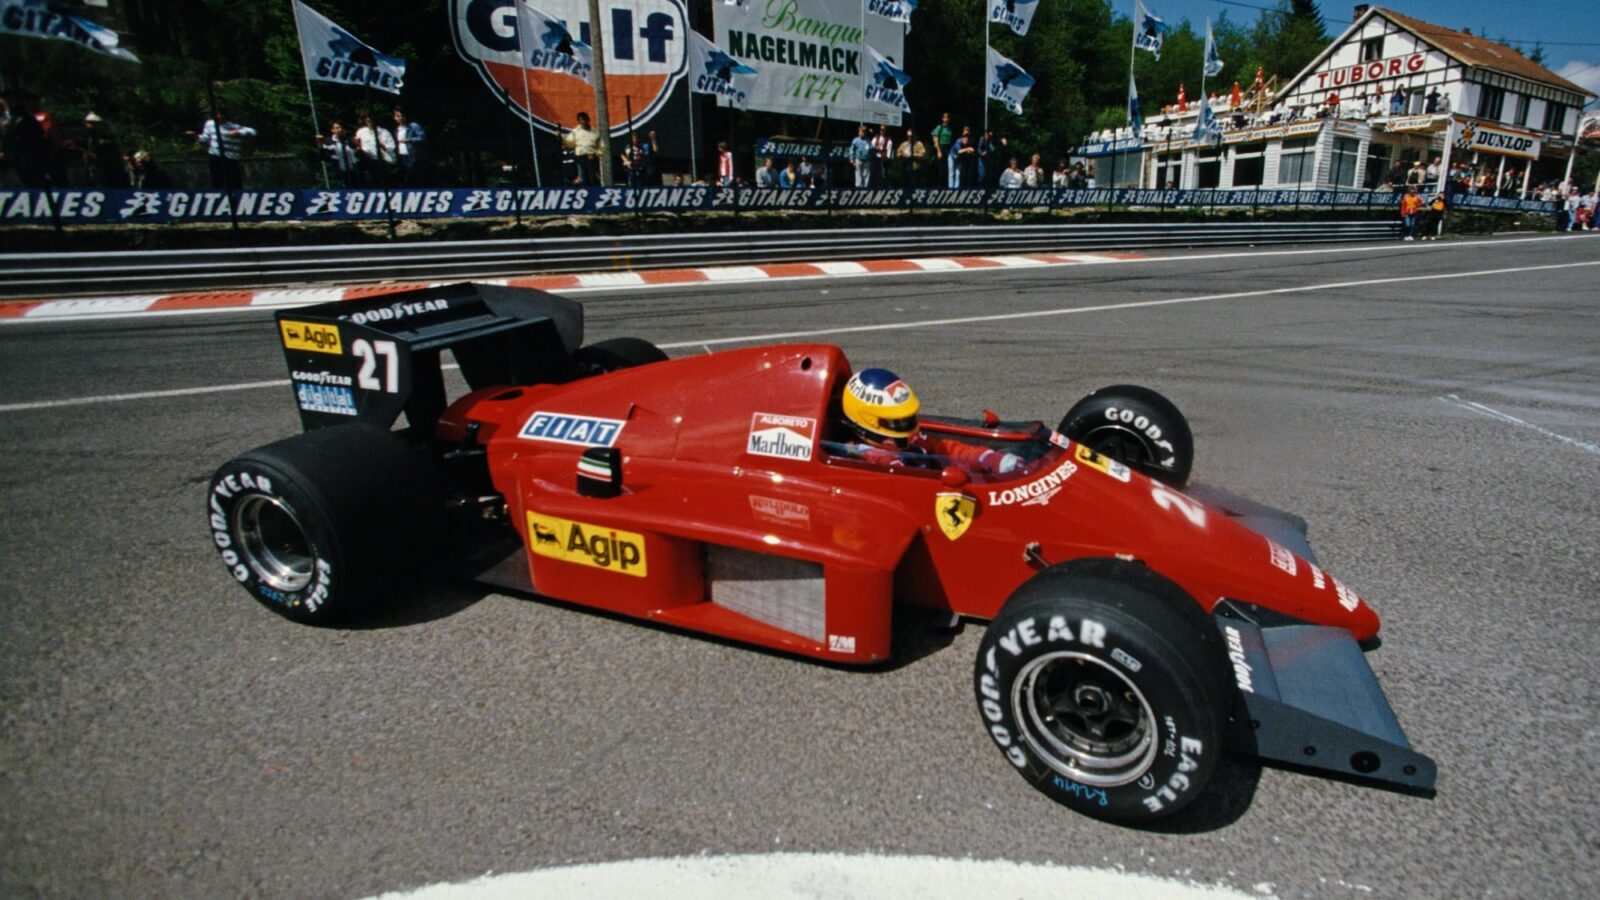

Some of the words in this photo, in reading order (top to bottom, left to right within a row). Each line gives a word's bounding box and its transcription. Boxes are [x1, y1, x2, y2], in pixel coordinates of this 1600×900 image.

[466, 0, 673, 62] Glf
[762, 0, 867, 46] Banque
[728, 29, 894, 75] NAGELMACK
[1318, 54, 1424, 88] TUBORG
[784, 73, 845, 102] 1747
[776, 142, 821, 156] GITANES
[1476, 130, 1533, 152] DUNLOP
[168, 192, 295, 217] GITANES
[738, 188, 813, 207] GITANES
[838, 190, 904, 206] GITANES
[926, 189, 986, 205] GITANES
[304, 325, 338, 349] Agip
[292, 370, 353, 387] GOODYEAR
[352, 338, 399, 394] 27
[529, 417, 616, 442] FIAT
[752, 432, 811, 458] Marlboro
[988, 459, 1078, 506] LONGINES
[567, 523, 640, 570] Agip
[1142, 735, 1203, 813] EAGLE
